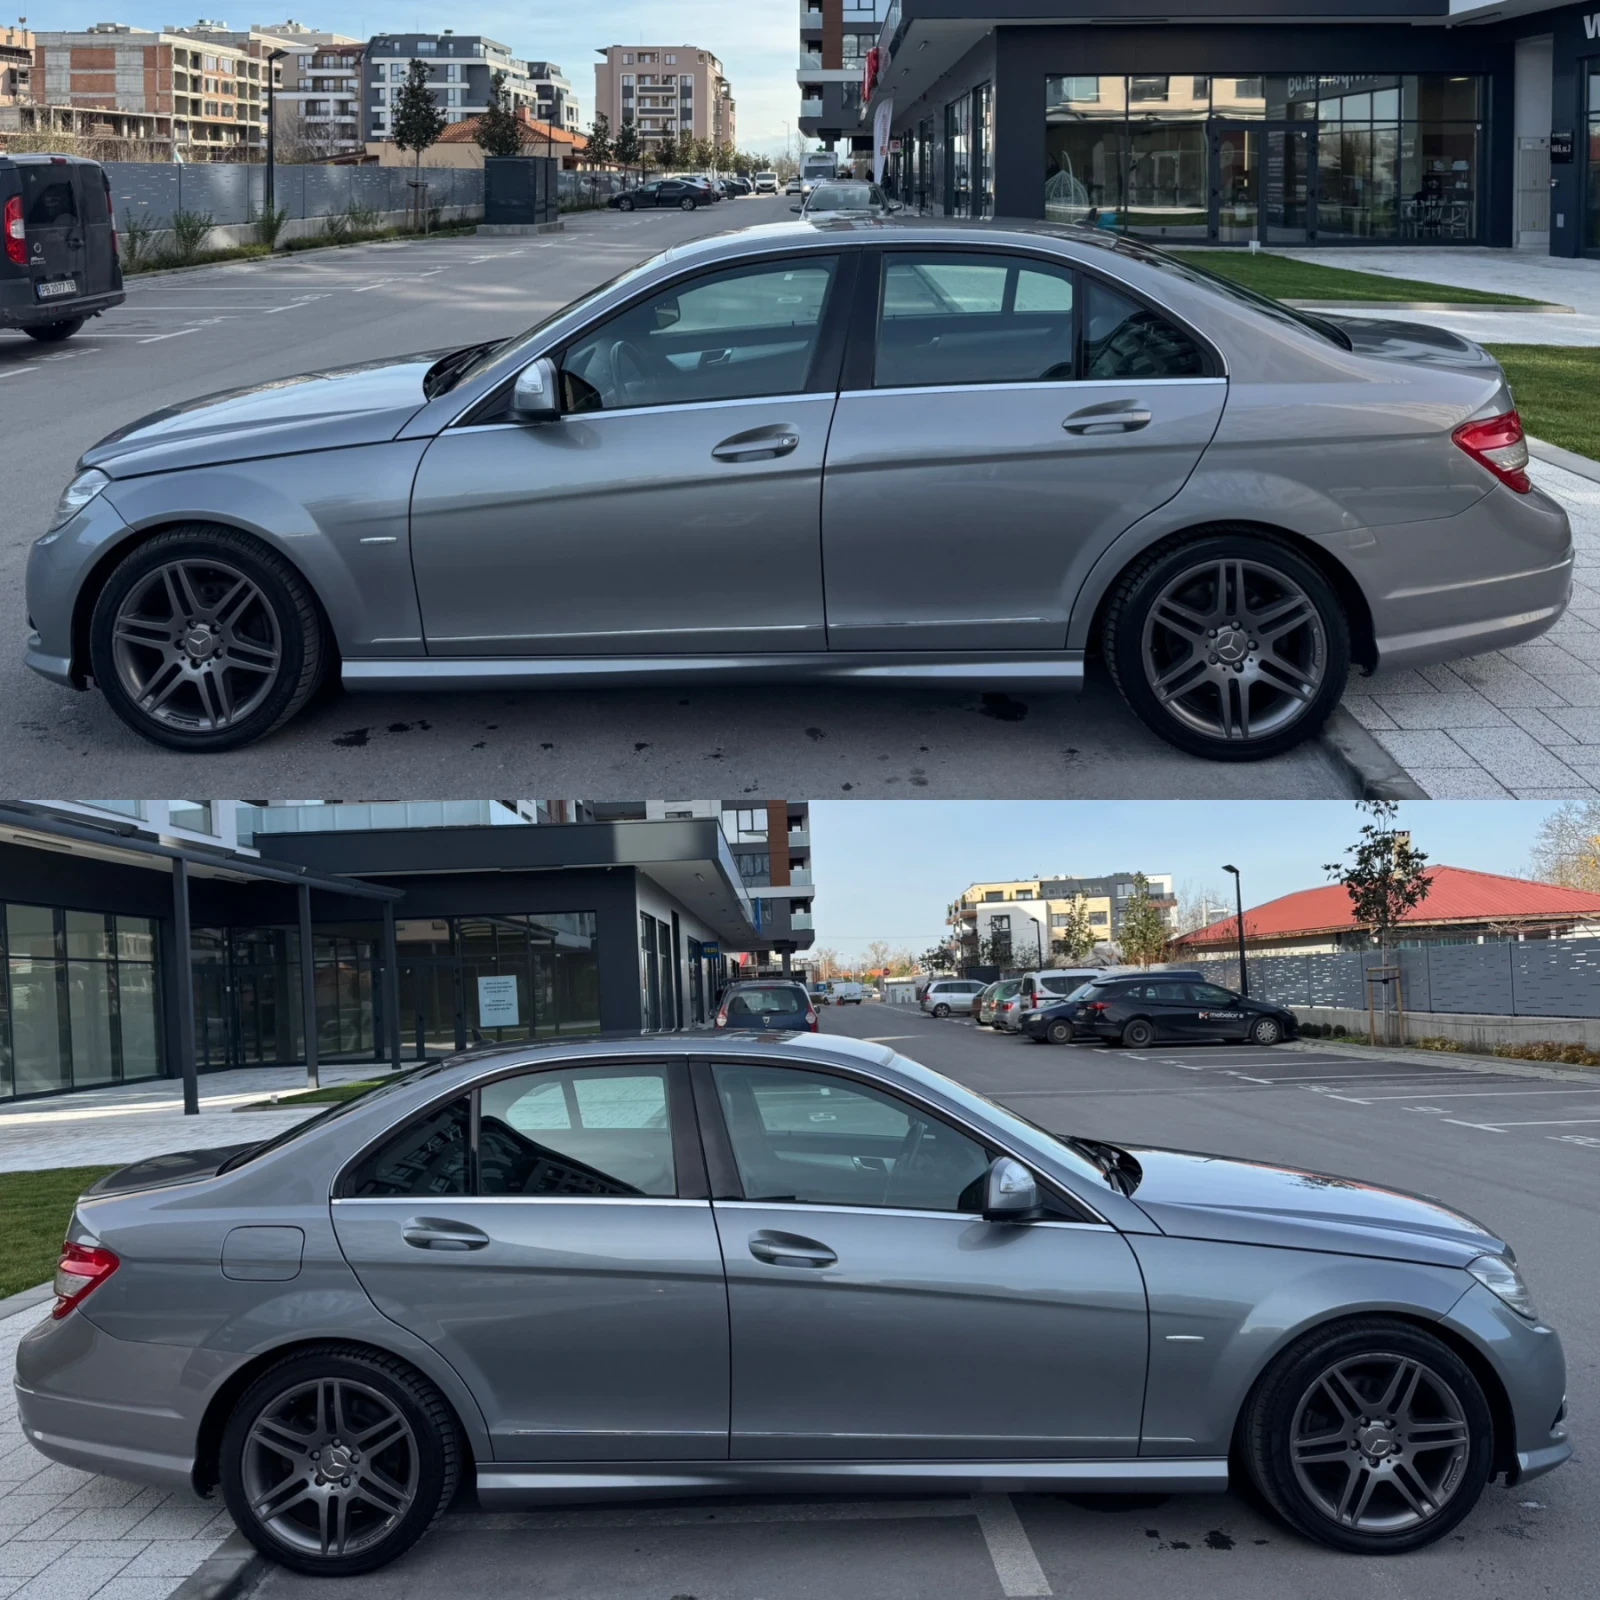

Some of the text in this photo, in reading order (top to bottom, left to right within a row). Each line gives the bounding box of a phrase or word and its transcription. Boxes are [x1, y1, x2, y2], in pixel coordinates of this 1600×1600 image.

[41, 281, 75, 295] PB 2077 TB
